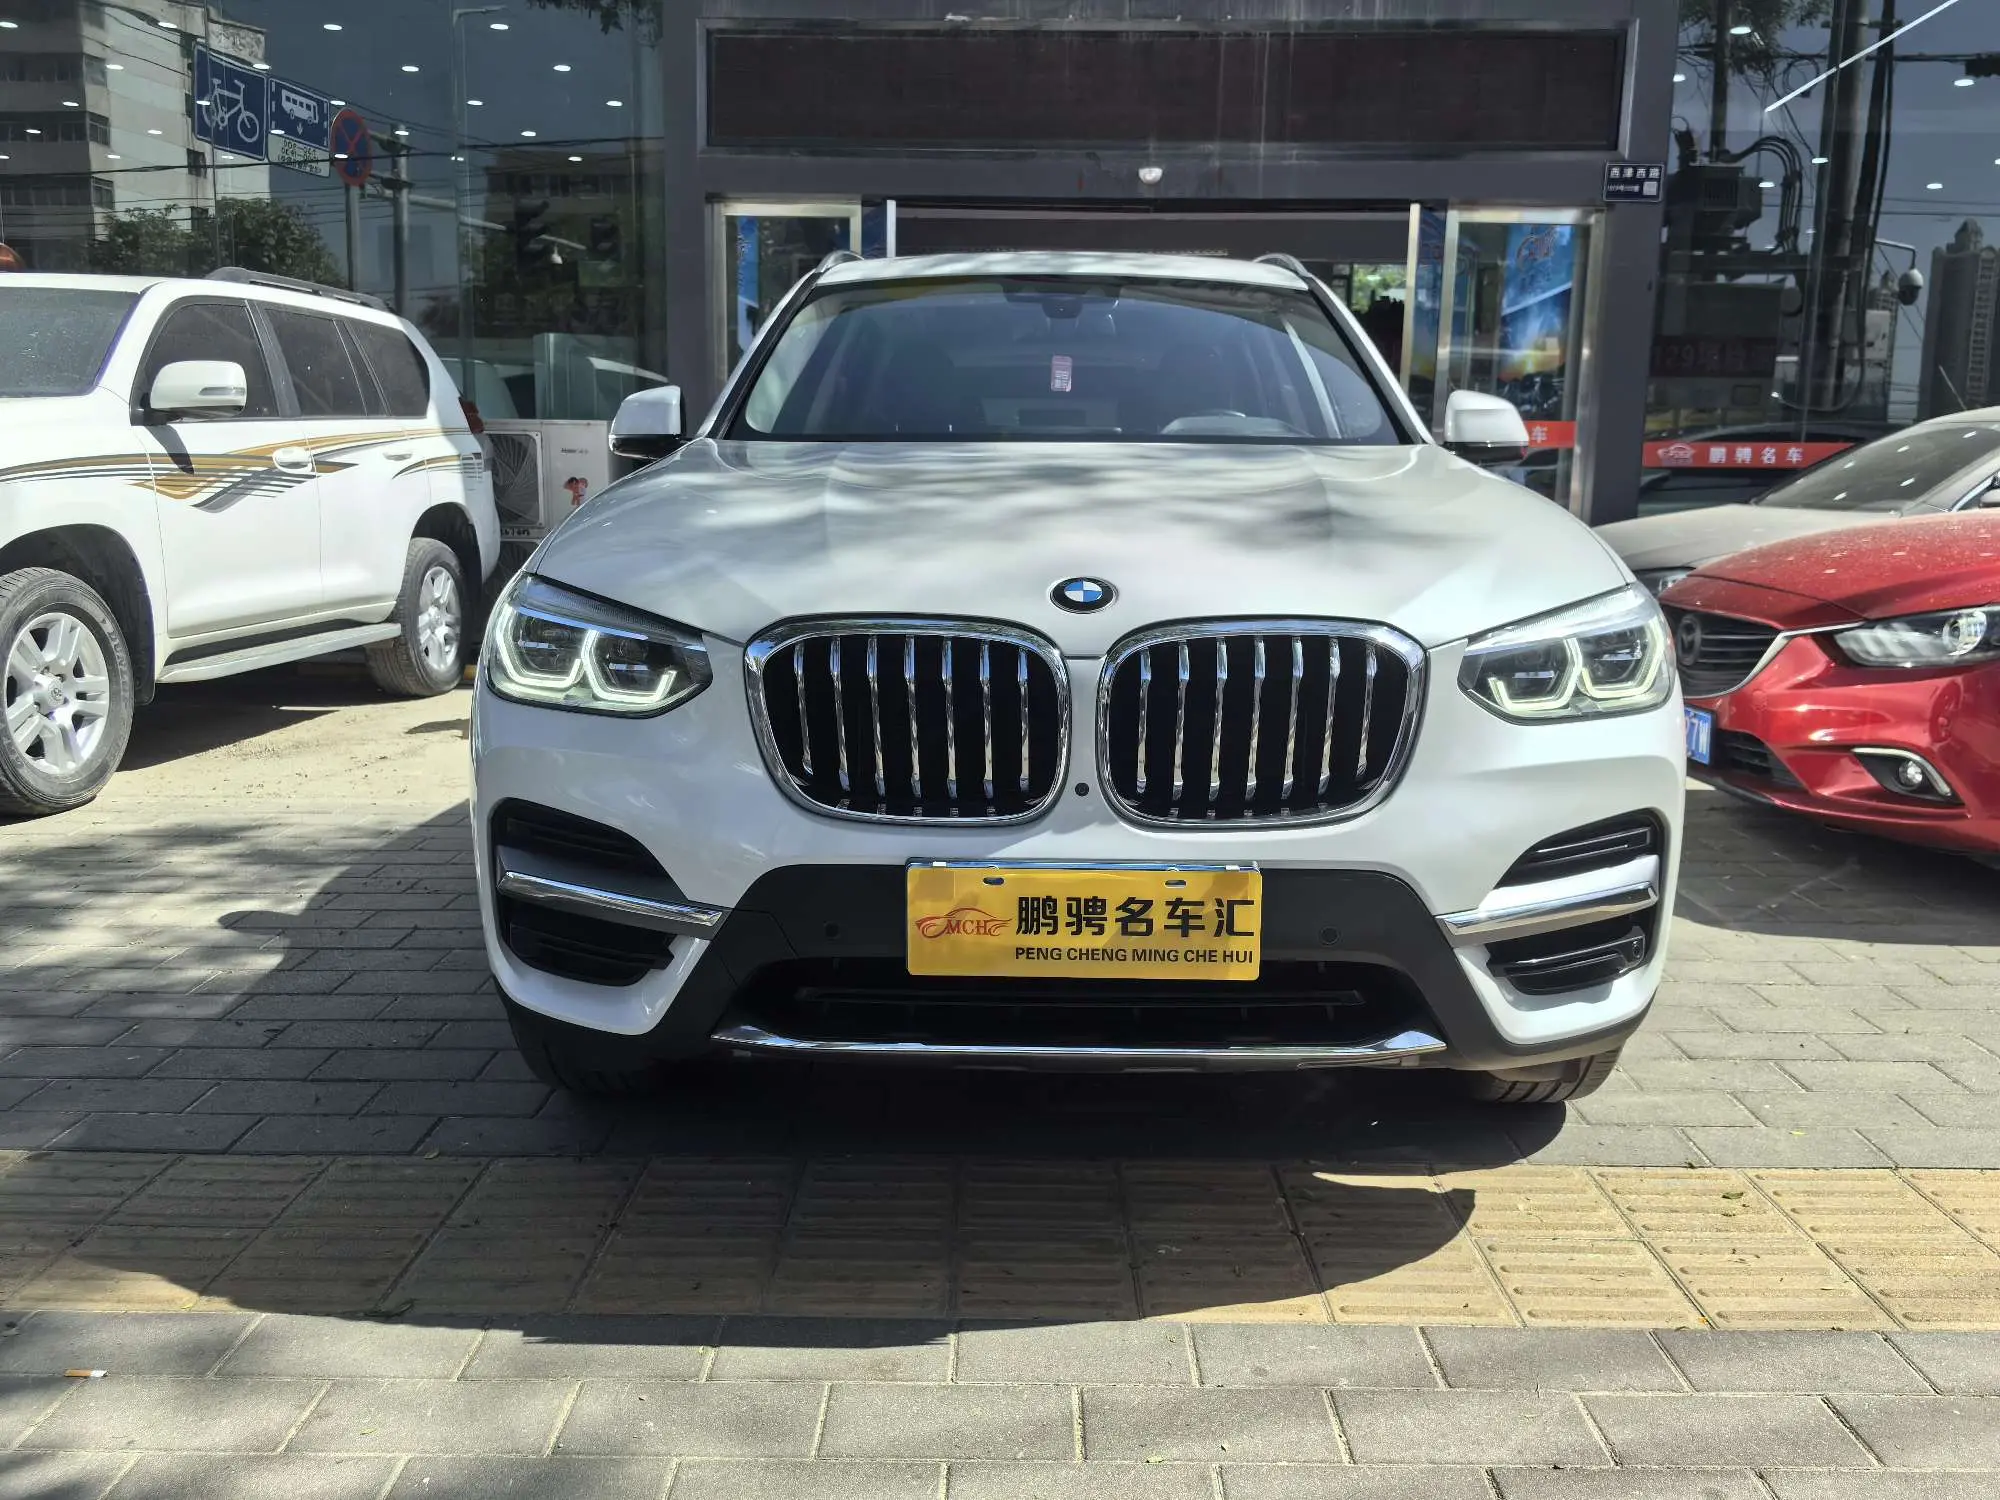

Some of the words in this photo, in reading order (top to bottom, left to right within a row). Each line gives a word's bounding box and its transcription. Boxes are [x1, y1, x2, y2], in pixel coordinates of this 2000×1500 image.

[1015, 896, 1255, 937] 鹏骋名车汇
[1015, 947, 1062, 961] PENG
[1066, 947, 1127, 961] CHENG
[1132, 949, 1179, 962] MING
[1184, 949, 1218, 963] CHE
[1222, 950, 1253, 963] HUI
